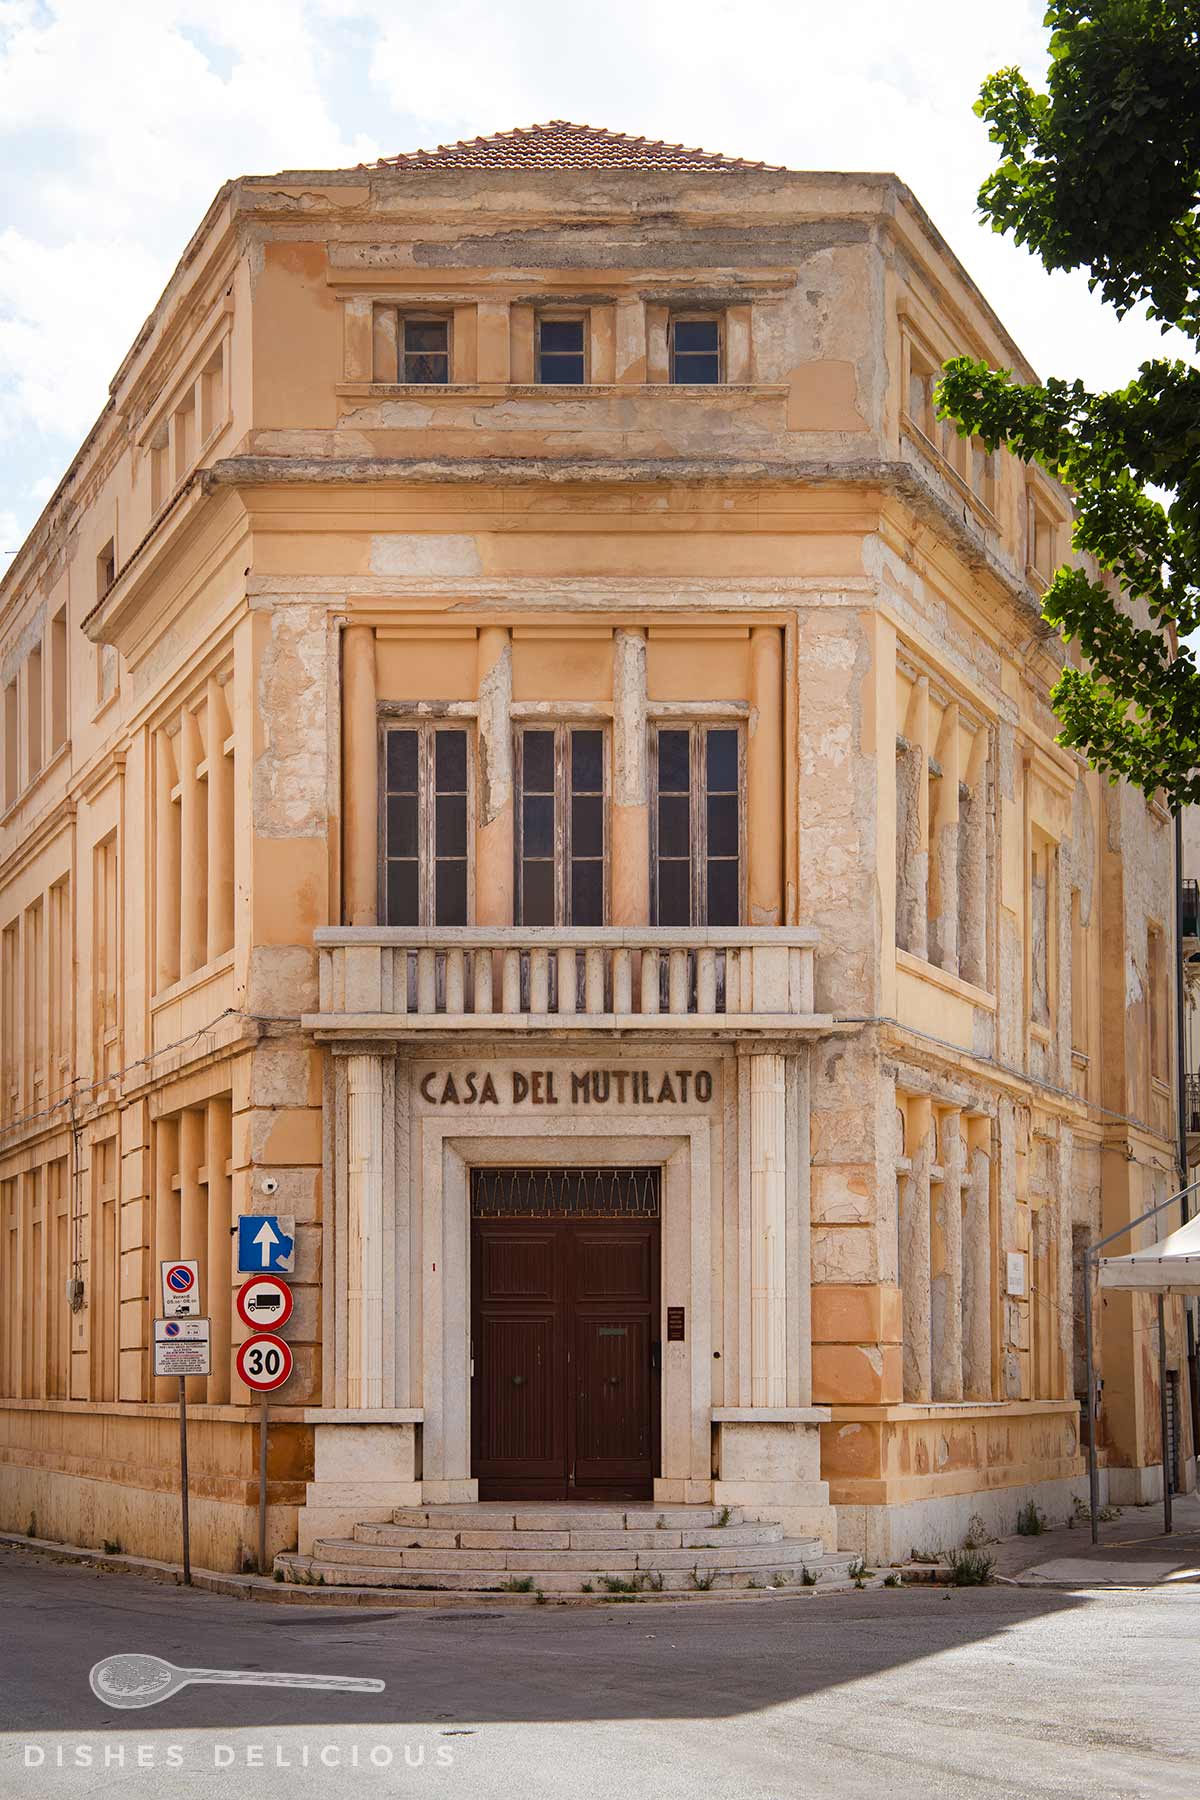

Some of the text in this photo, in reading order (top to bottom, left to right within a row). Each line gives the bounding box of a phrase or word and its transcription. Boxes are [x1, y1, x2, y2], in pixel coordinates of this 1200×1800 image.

[420, 1069, 713, 1105] CASA DEL MUTILATO
[248, 1348, 280, 1376] 30
